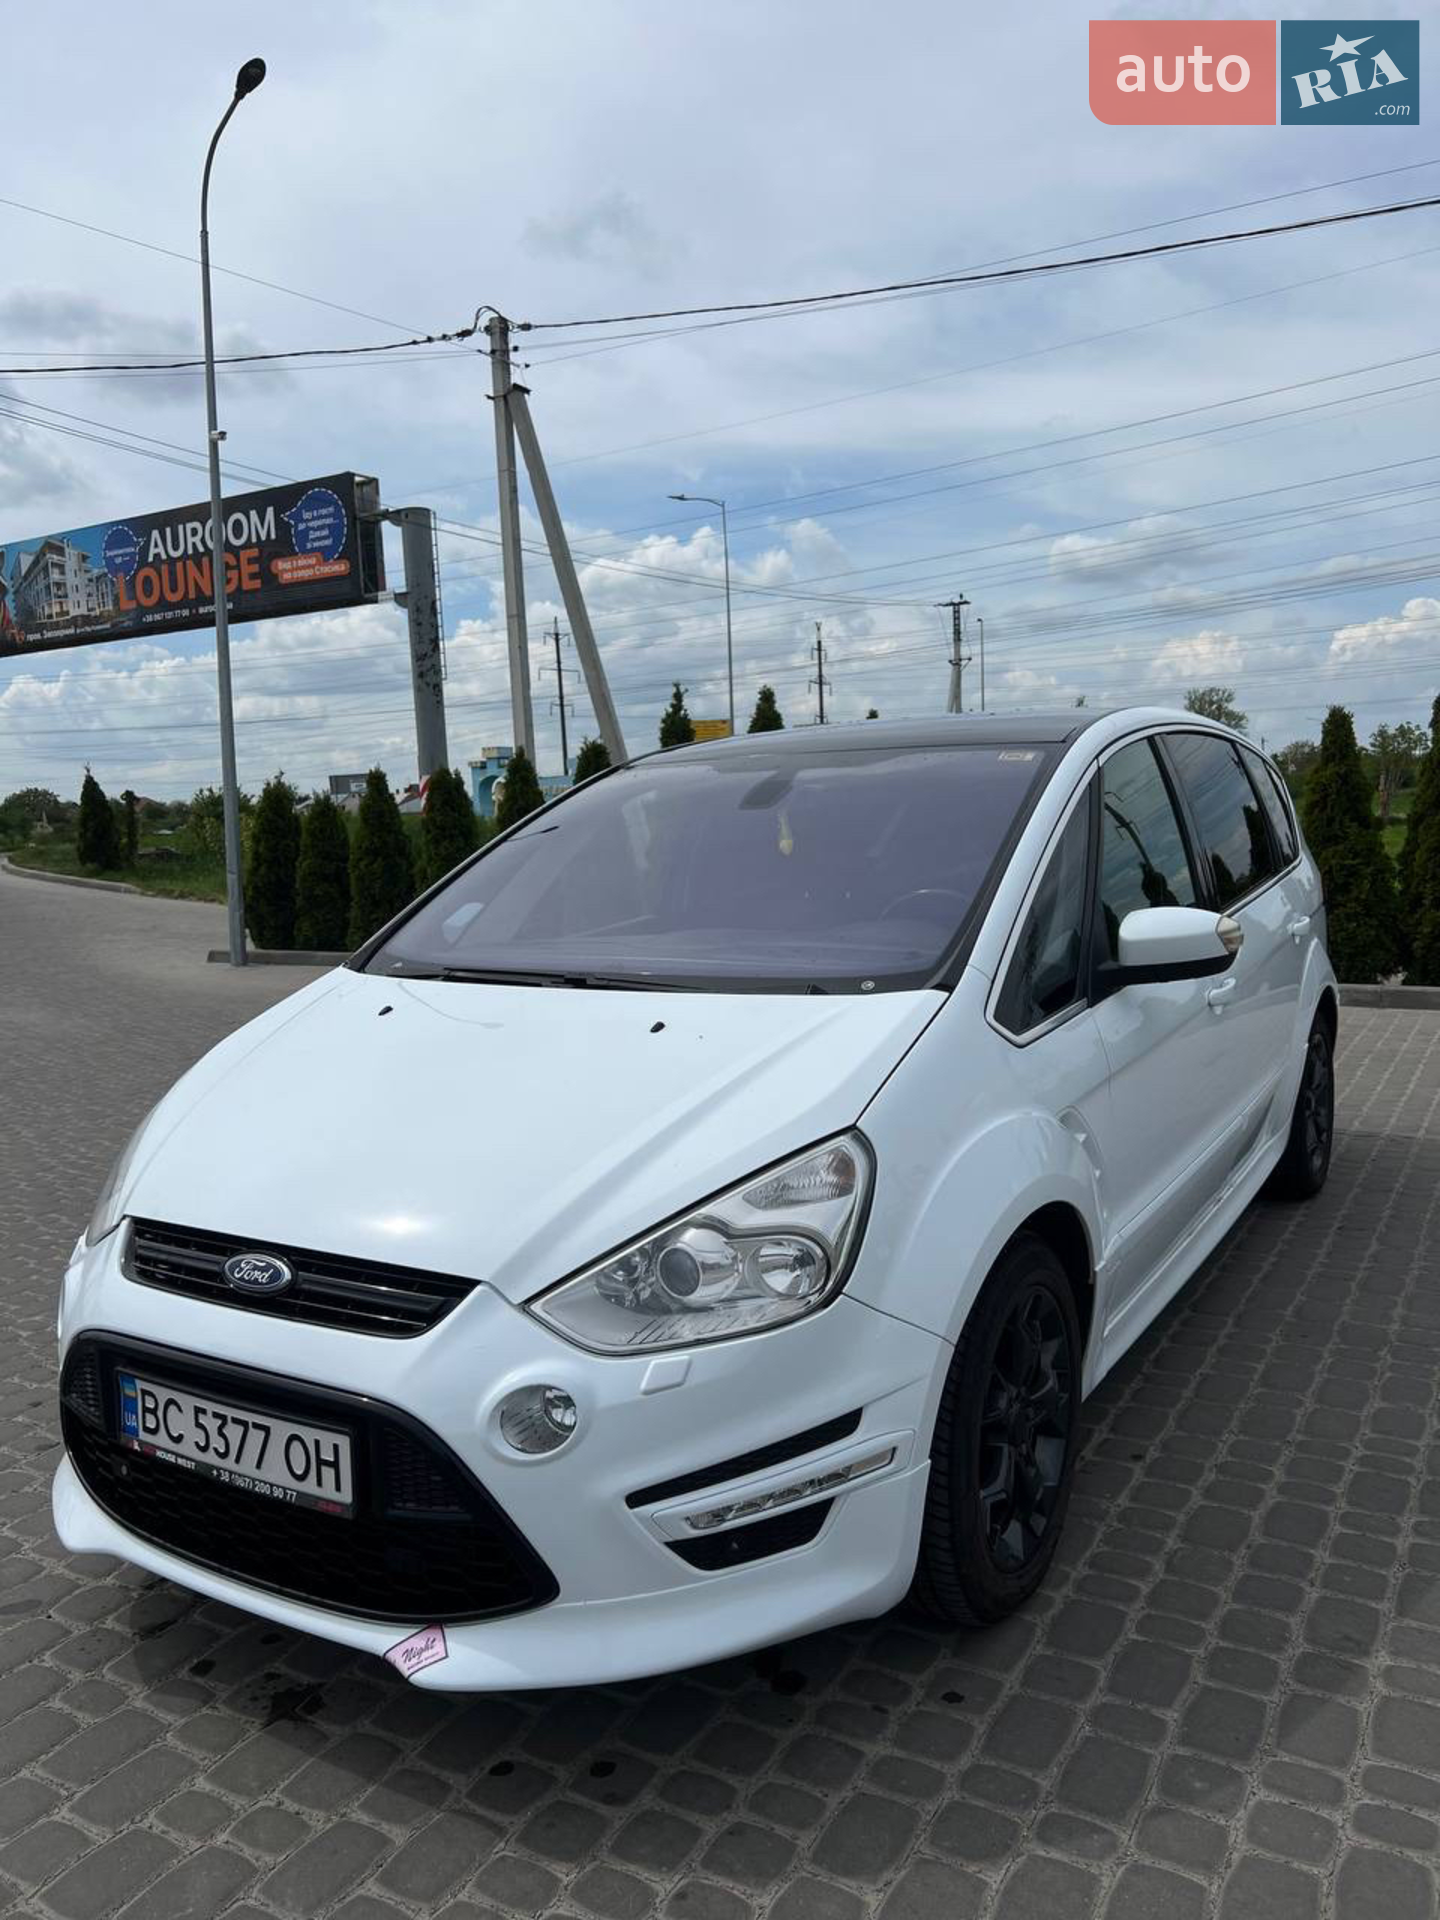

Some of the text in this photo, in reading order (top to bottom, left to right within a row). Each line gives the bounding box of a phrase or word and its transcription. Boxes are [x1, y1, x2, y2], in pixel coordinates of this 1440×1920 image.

[148, 506, 277, 562] AUROOM
[119, 547, 262, 611] LOUNGE
[234, 1259, 274, 1283] Ford
[125, 1411, 138, 1428] UA
[140, 1387, 342, 1494] BC 5377 OH
[401, 1636, 437, 1664] Night
